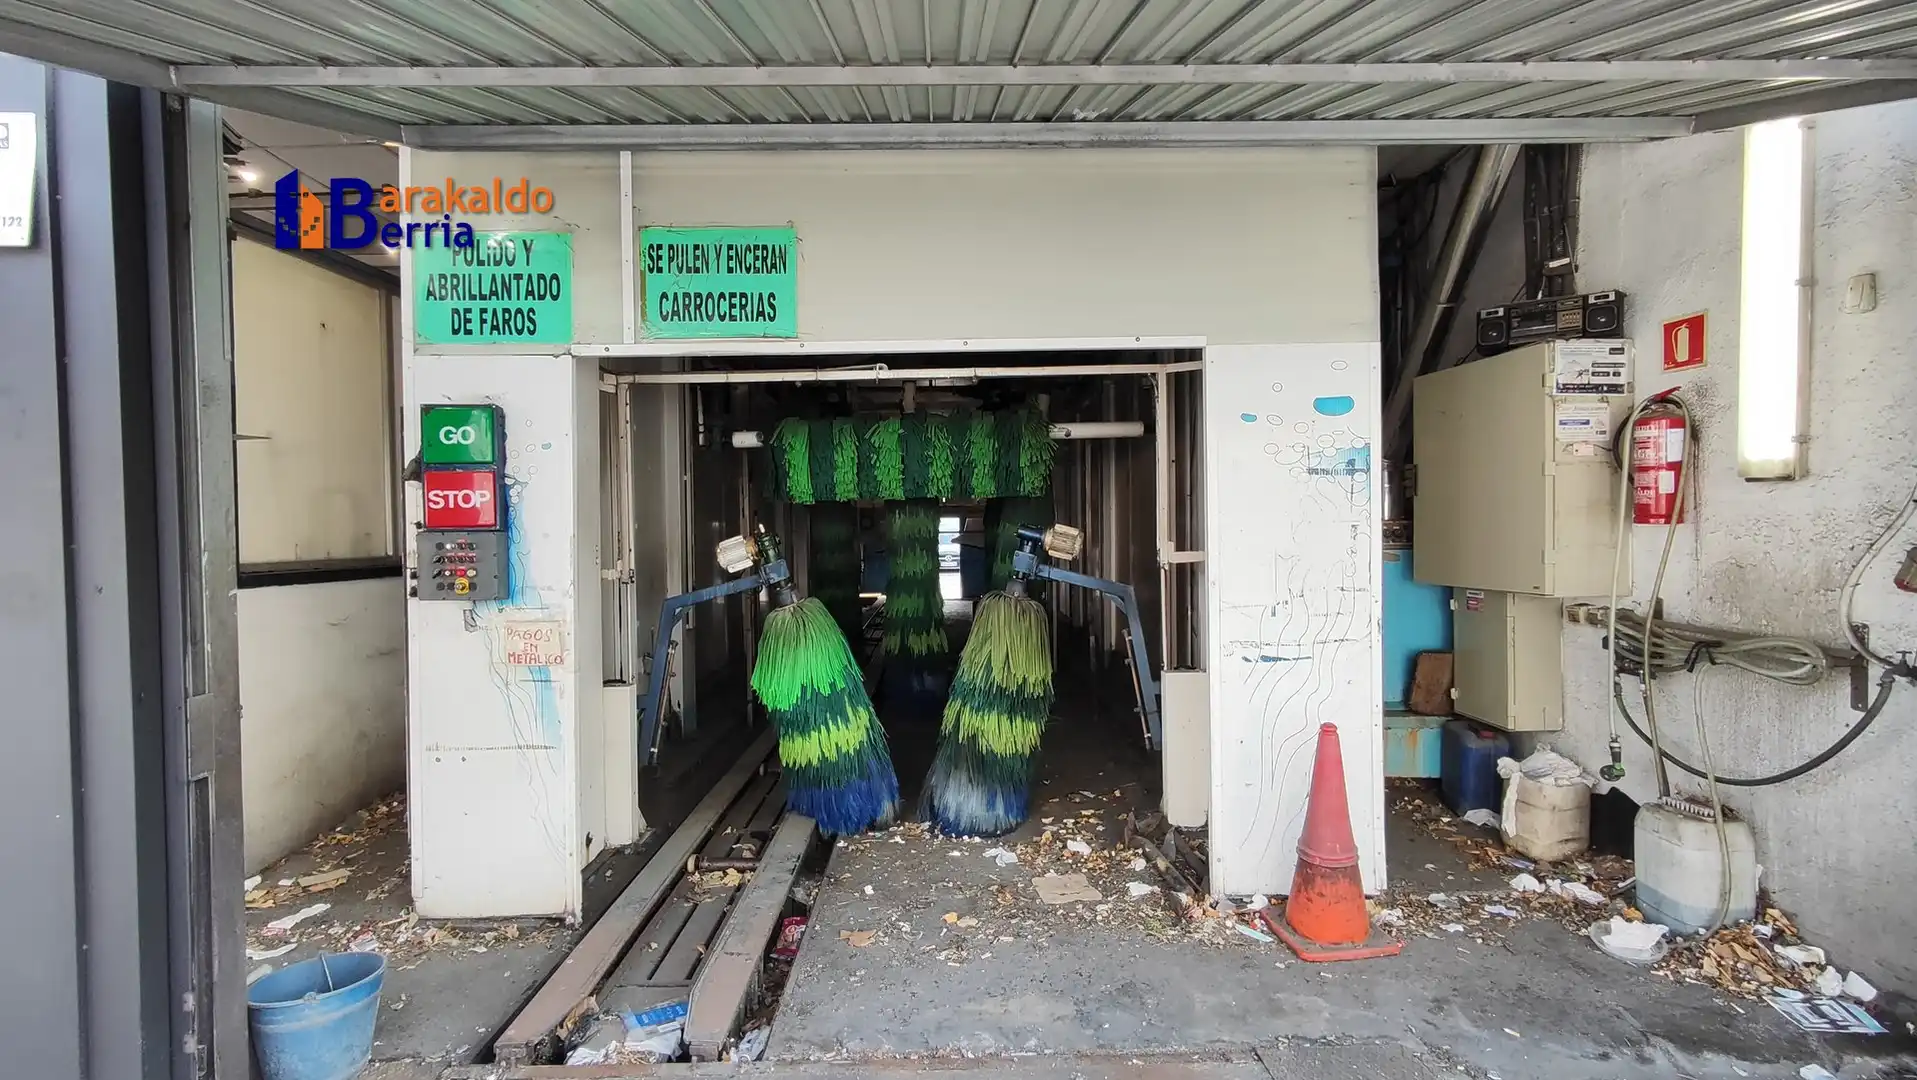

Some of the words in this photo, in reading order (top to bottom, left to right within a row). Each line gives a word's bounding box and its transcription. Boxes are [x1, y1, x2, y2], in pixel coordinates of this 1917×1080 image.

[522, 239, 534, 267] Y
[647, 243, 663, 274] SE
[667, 244, 709, 274] PULEN
[714, 244, 723, 274] Y
[726, 244, 787, 274] ENCERAN
[426, 273, 561, 301] ABRILLANTADO
[659, 291, 777, 322] CARROCERIAS
[451, 307, 473, 335] DE
[479, 307, 537, 335] FAROS
[439, 425, 475, 445] GO
[428, 489, 491, 509] STOP
[506, 627, 552, 642] PAGOS
[523, 642, 538, 652] EN
